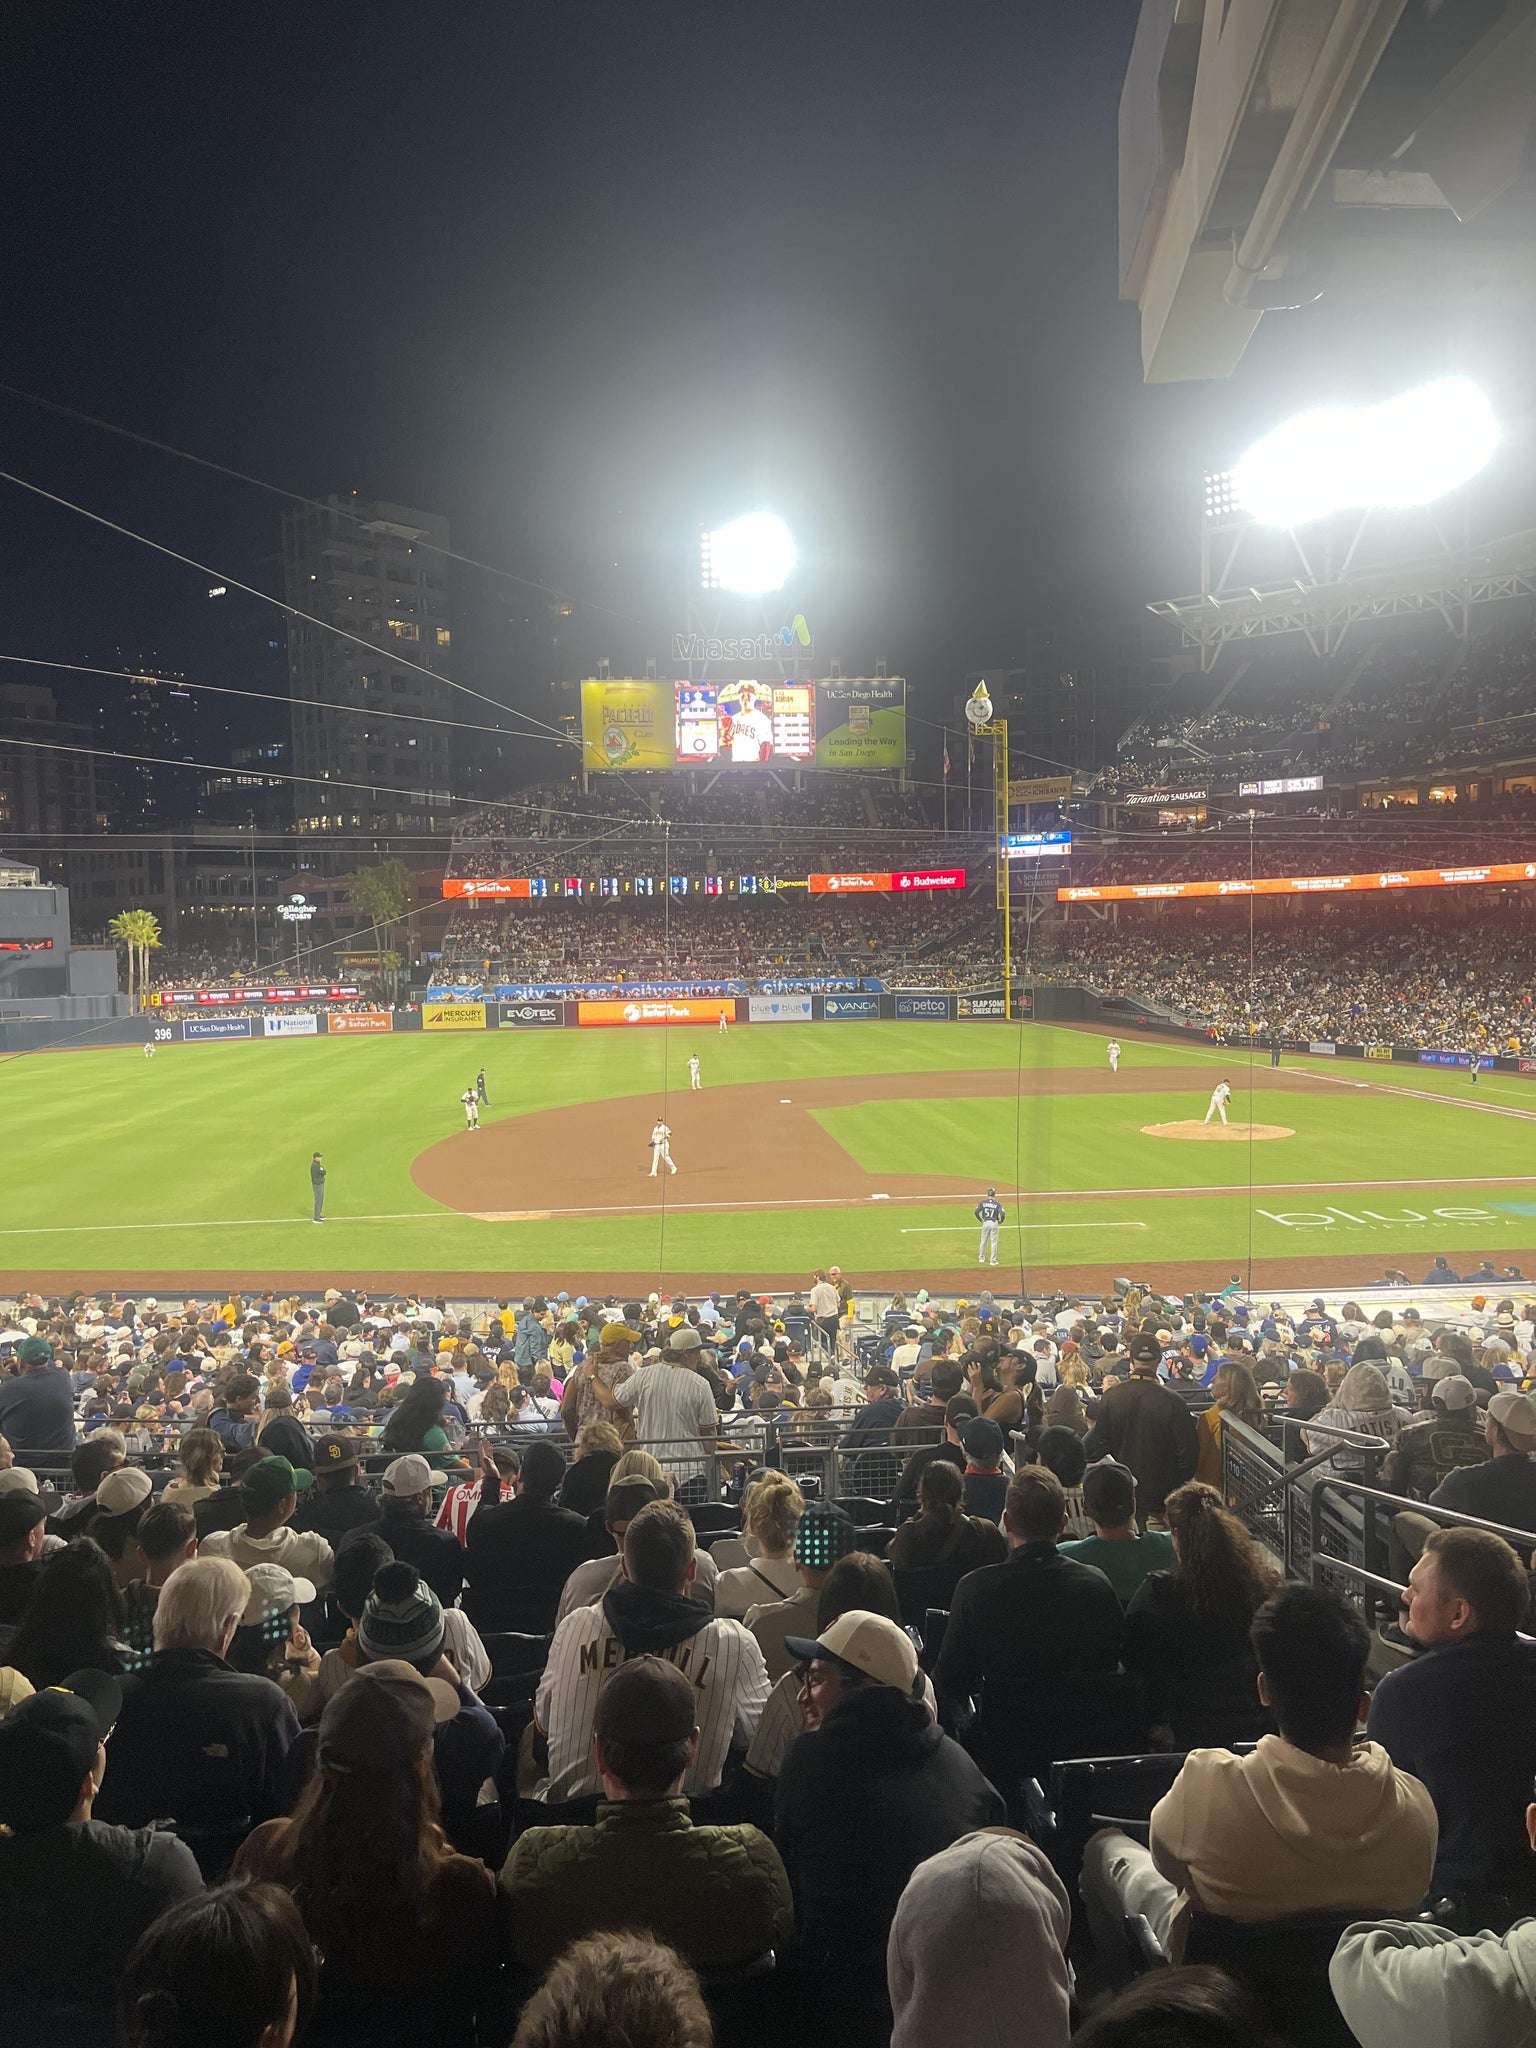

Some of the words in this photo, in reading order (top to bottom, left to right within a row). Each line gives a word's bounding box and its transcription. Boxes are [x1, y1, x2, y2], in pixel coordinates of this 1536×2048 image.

[675, 633, 773, 660] Viasat
[827, 690, 839, 698] UC
[852, 690, 871, 699] Diego
[871, 690, 893, 698] Health
[829, 738, 863, 747] Leading
[864, 737, 877, 745] the
[879, 737, 897, 746] Way
[839, 749, 853, 757] San
[856, 749, 876, 757] Diego
[1125, 791, 1169, 805] Tarantino
[1170, 791, 1207, 801] SAUSAGES
[717, 876, 722, 885] 5
[729, 880, 735, 890] F
[764, 880, 769, 889] 6
[860, 879, 874, 887] Park
[913, 875, 957, 887] Budweiser
[554, 883, 559, 892] F
[590, 882, 595, 891] F
[625, 882, 630, 891] F
[660, 882, 665, 891] F
[695, 881, 700, 890] F
[752, 884, 757, 893] 2
[542, 888, 548, 896] 2
[612, 887, 618, 896] 6
[647, 887, 653, 895] 5
[682, 886, 687, 895] 7
[277, 904, 317, 914] Gallagher
[283, 912, 312, 921] Square
[751, 1003, 770, 1012] blue
[781, 1002, 801, 1011] blue
[838, 1002, 877, 1010] VANDA
[913, 999, 945, 1013] petco
[972, 1000, 988, 1008] SLAP
[507, 1007, 555, 1020] EVOTEK
[642, 1008, 669, 1017] Safari
[669, 1007, 690, 1016] Park
[972, 1007, 991, 1015] CHEESE
[211, 1024, 226, 1032] Diego
[226, 1023, 245, 1031] Health
[349, 1020, 370, 1028] Safari
[370, 1019, 387, 1027] Park
[154, 1028, 172, 1041] 396
[984, 1207, 995, 1218] 57
[1256, 1206, 1499, 1226] blue
[1229, 1460, 1240, 1477] 110
[579, 1636, 710, 1690] MEILL
